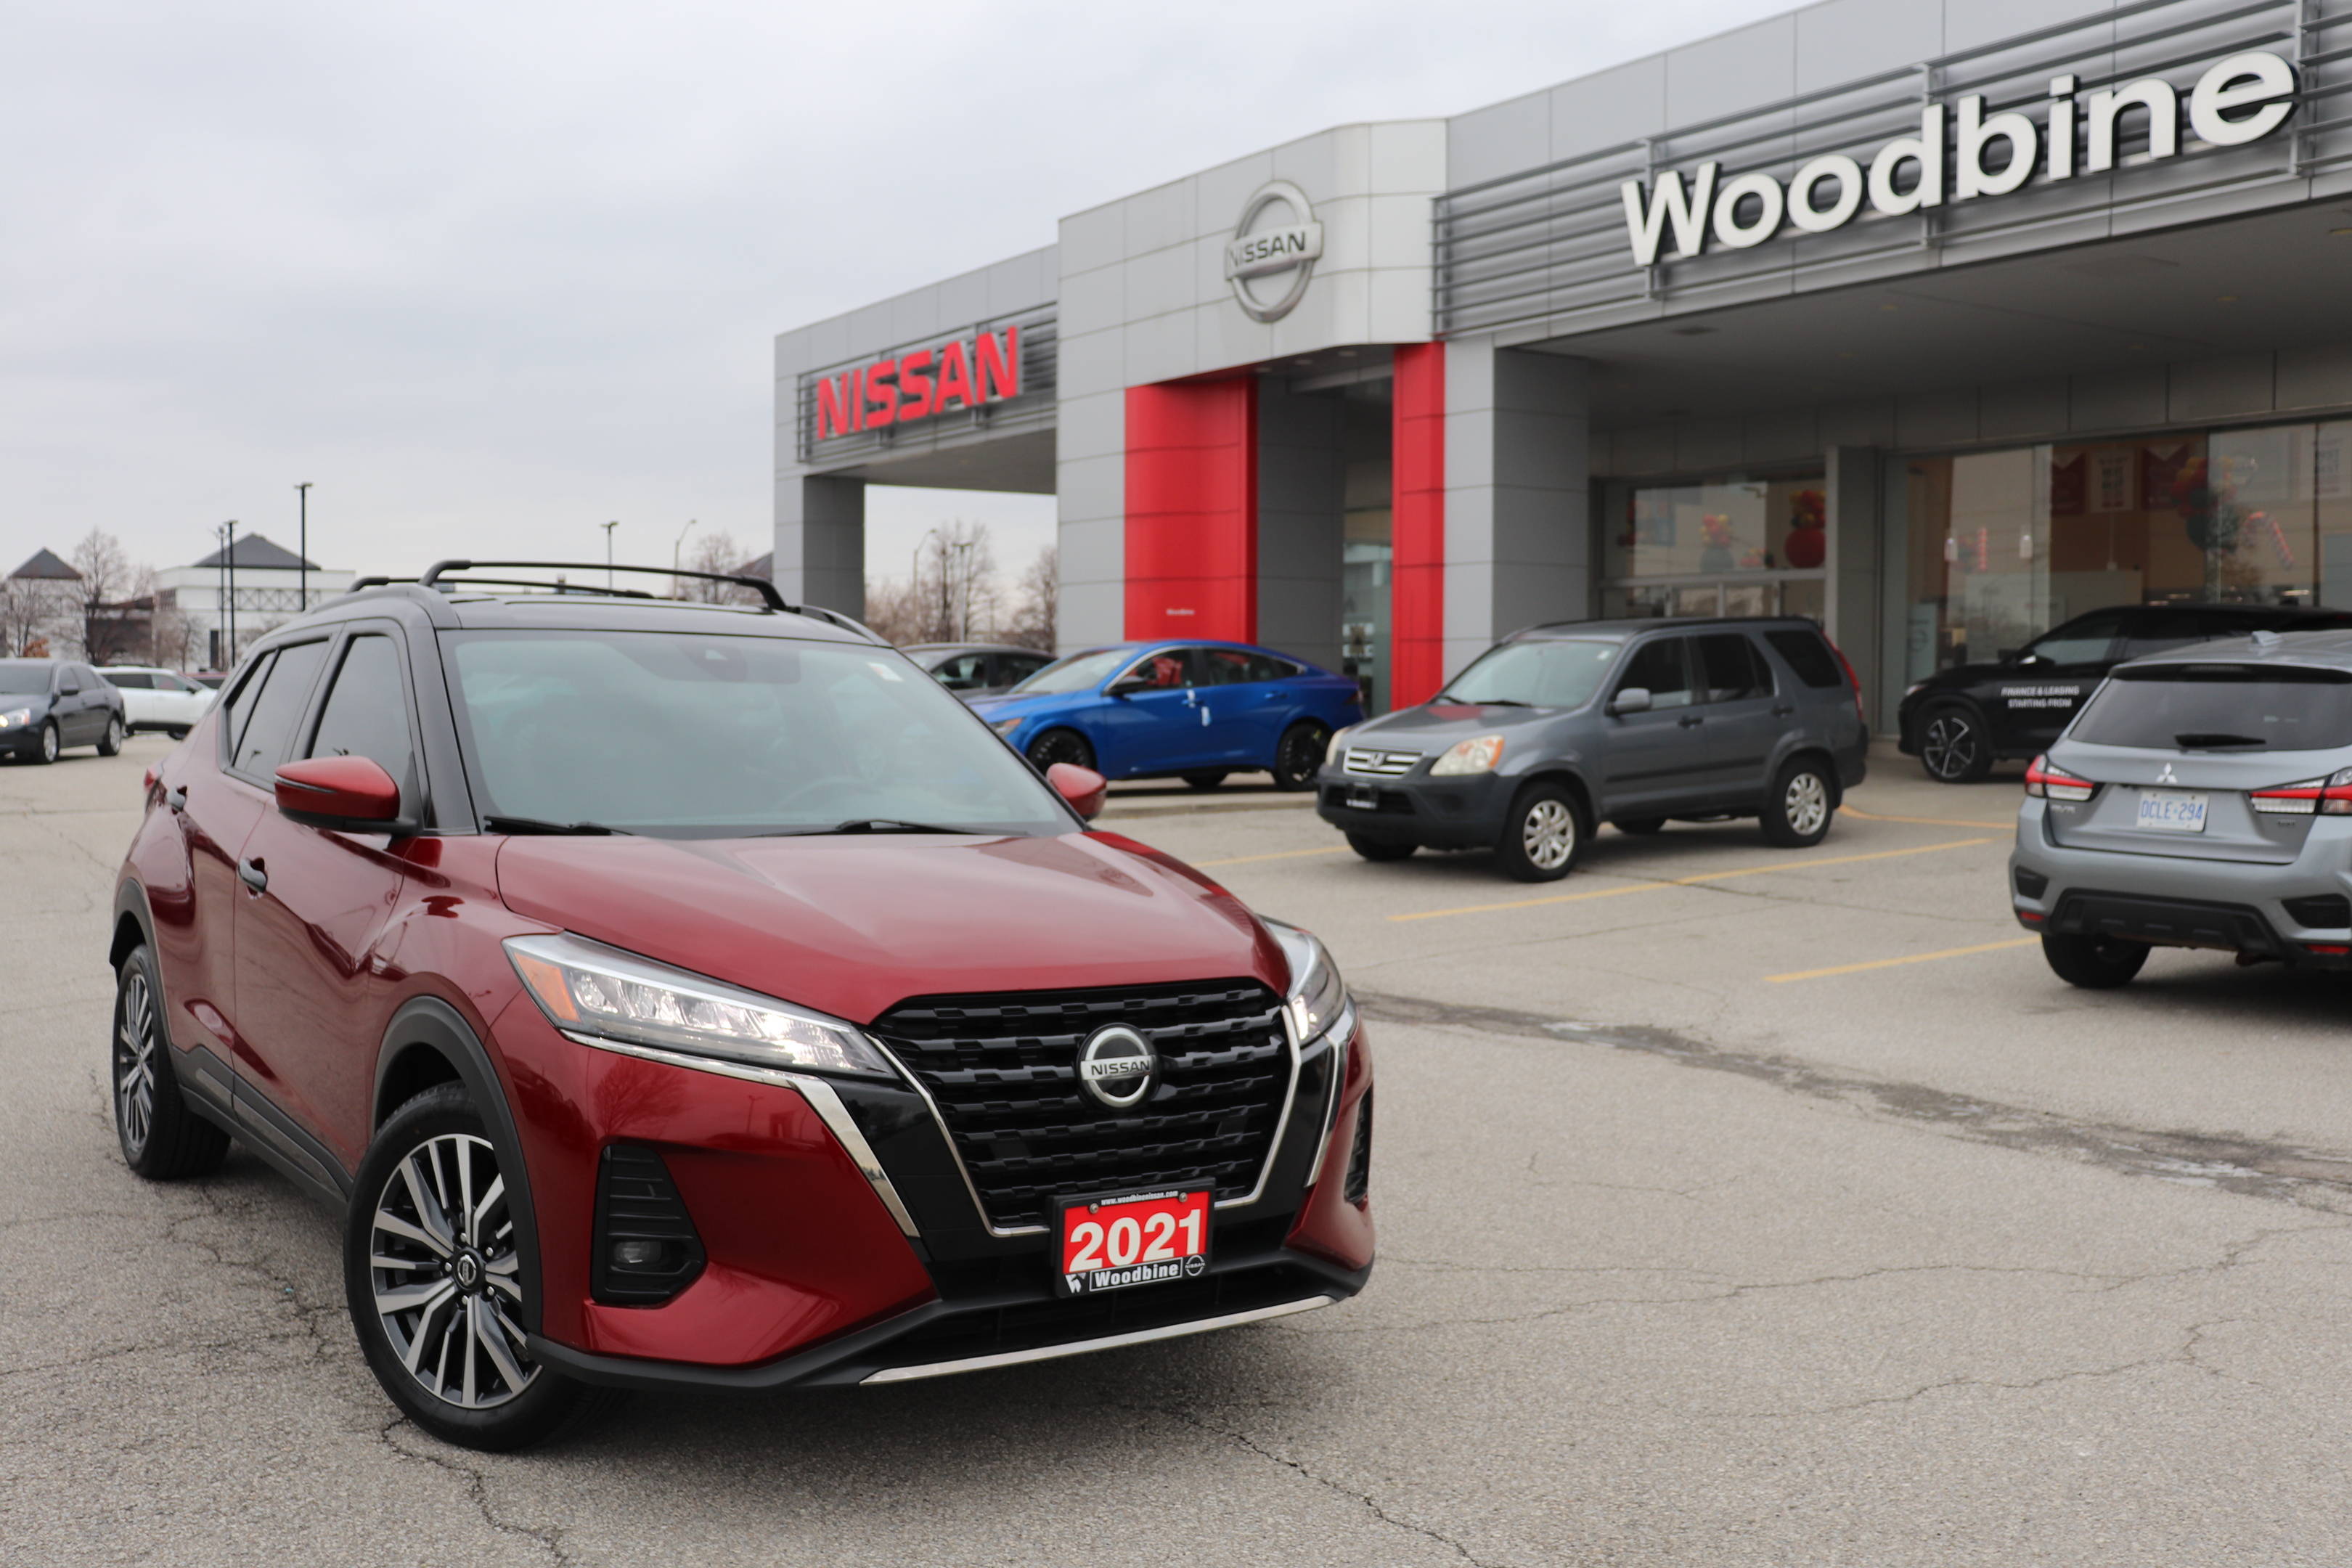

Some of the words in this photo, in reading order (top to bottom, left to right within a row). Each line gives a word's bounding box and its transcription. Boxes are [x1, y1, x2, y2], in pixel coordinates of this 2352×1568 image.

[1620, 50, 2298, 267] Woodbine
[1228, 231, 1306, 267] NISSAN
[817, 326, 1018, 440] NISSAN
[2001, 686, 2036, 696] FINANCE
[2037, 686, 2043, 696] &
[2044, 685, 2080, 696] LEASING
[2007, 698, 2047, 709] STARTING
[2047, 698, 2073, 708] FROM
[1090, 1060, 1150, 1075] NISSAN
[1101, 1191, 1179, 1206] www.woodbinenissan.com
[1069, 1209, 1201, 1273] 2021
[1095, 1263, 1179, 1288] Woodbine
